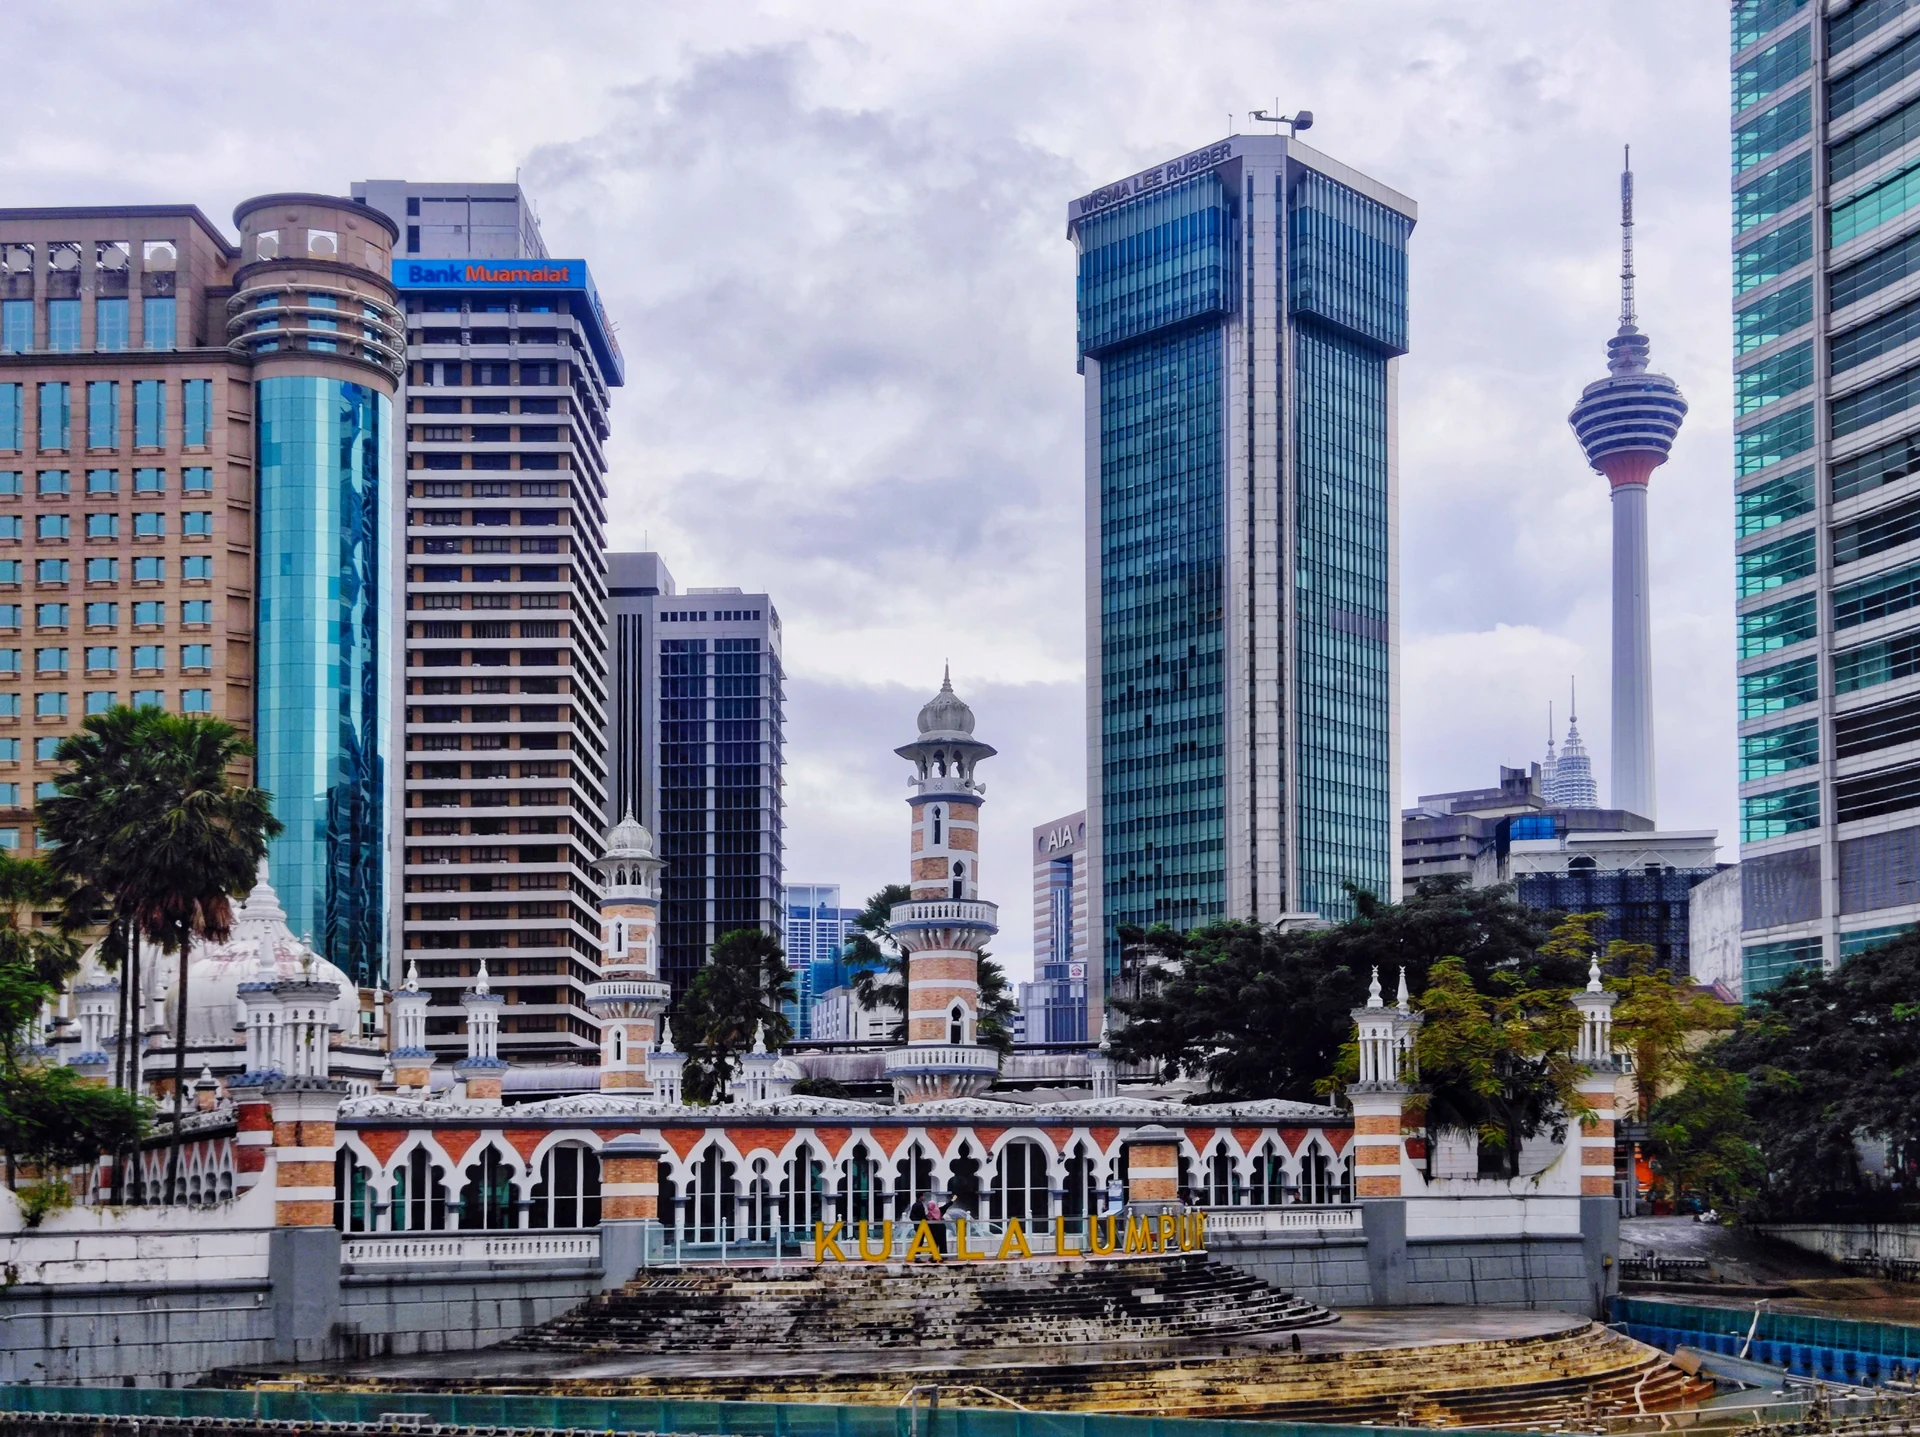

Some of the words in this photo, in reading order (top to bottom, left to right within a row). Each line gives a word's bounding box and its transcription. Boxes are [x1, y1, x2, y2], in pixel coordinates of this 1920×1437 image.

[1079, 182, 1131, 213] WISMA
[1133, 168, 1163, 192] LEE
[1166, 142, 1232, 181] RUBBER
[409, 265, 463, 283] Bank
[465, 265, 570, 283] Muamalat
[1048, 824, 1074, 853] AIA
[815, 1216, 1032, 1263] KUALA
[1056, 1212, 1207, 1257] LUMPUR
